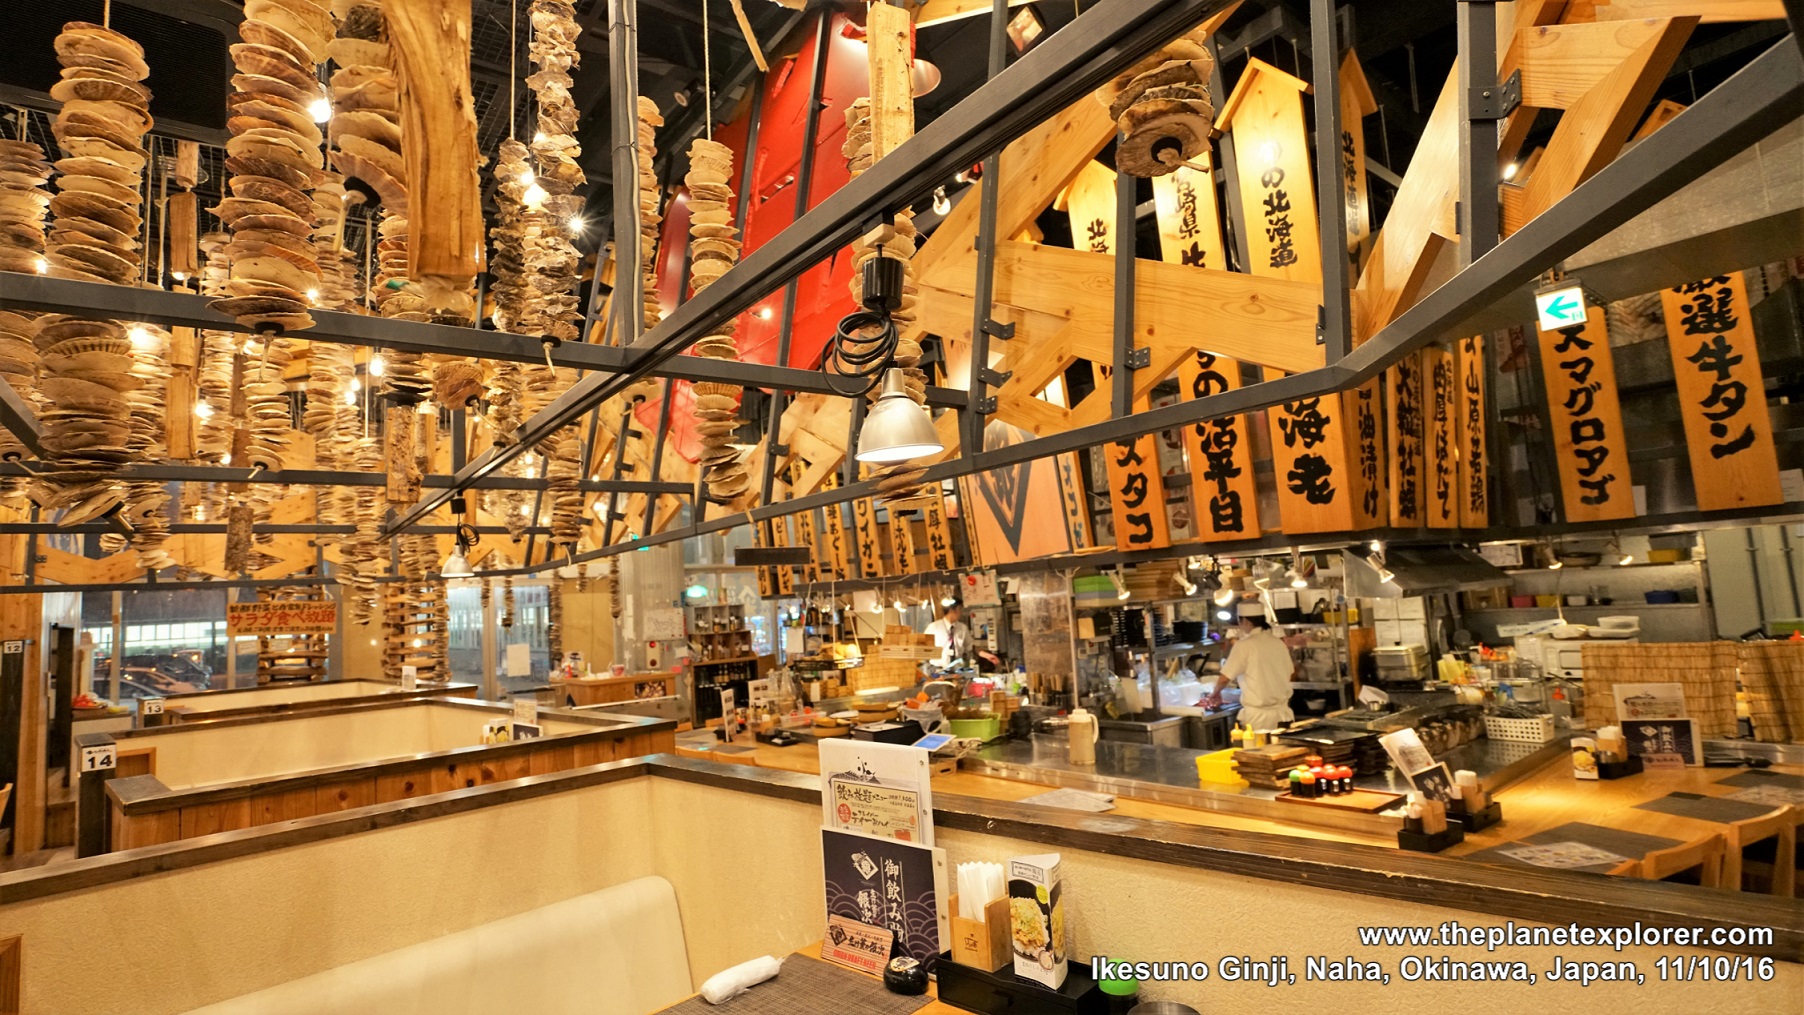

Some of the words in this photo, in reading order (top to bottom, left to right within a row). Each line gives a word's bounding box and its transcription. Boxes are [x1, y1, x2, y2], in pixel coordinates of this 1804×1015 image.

[229, 610, 336, 627] サラダ食べ放題
[147, 705, 162, 713] 13
[88, 755, 113, 769] 14
